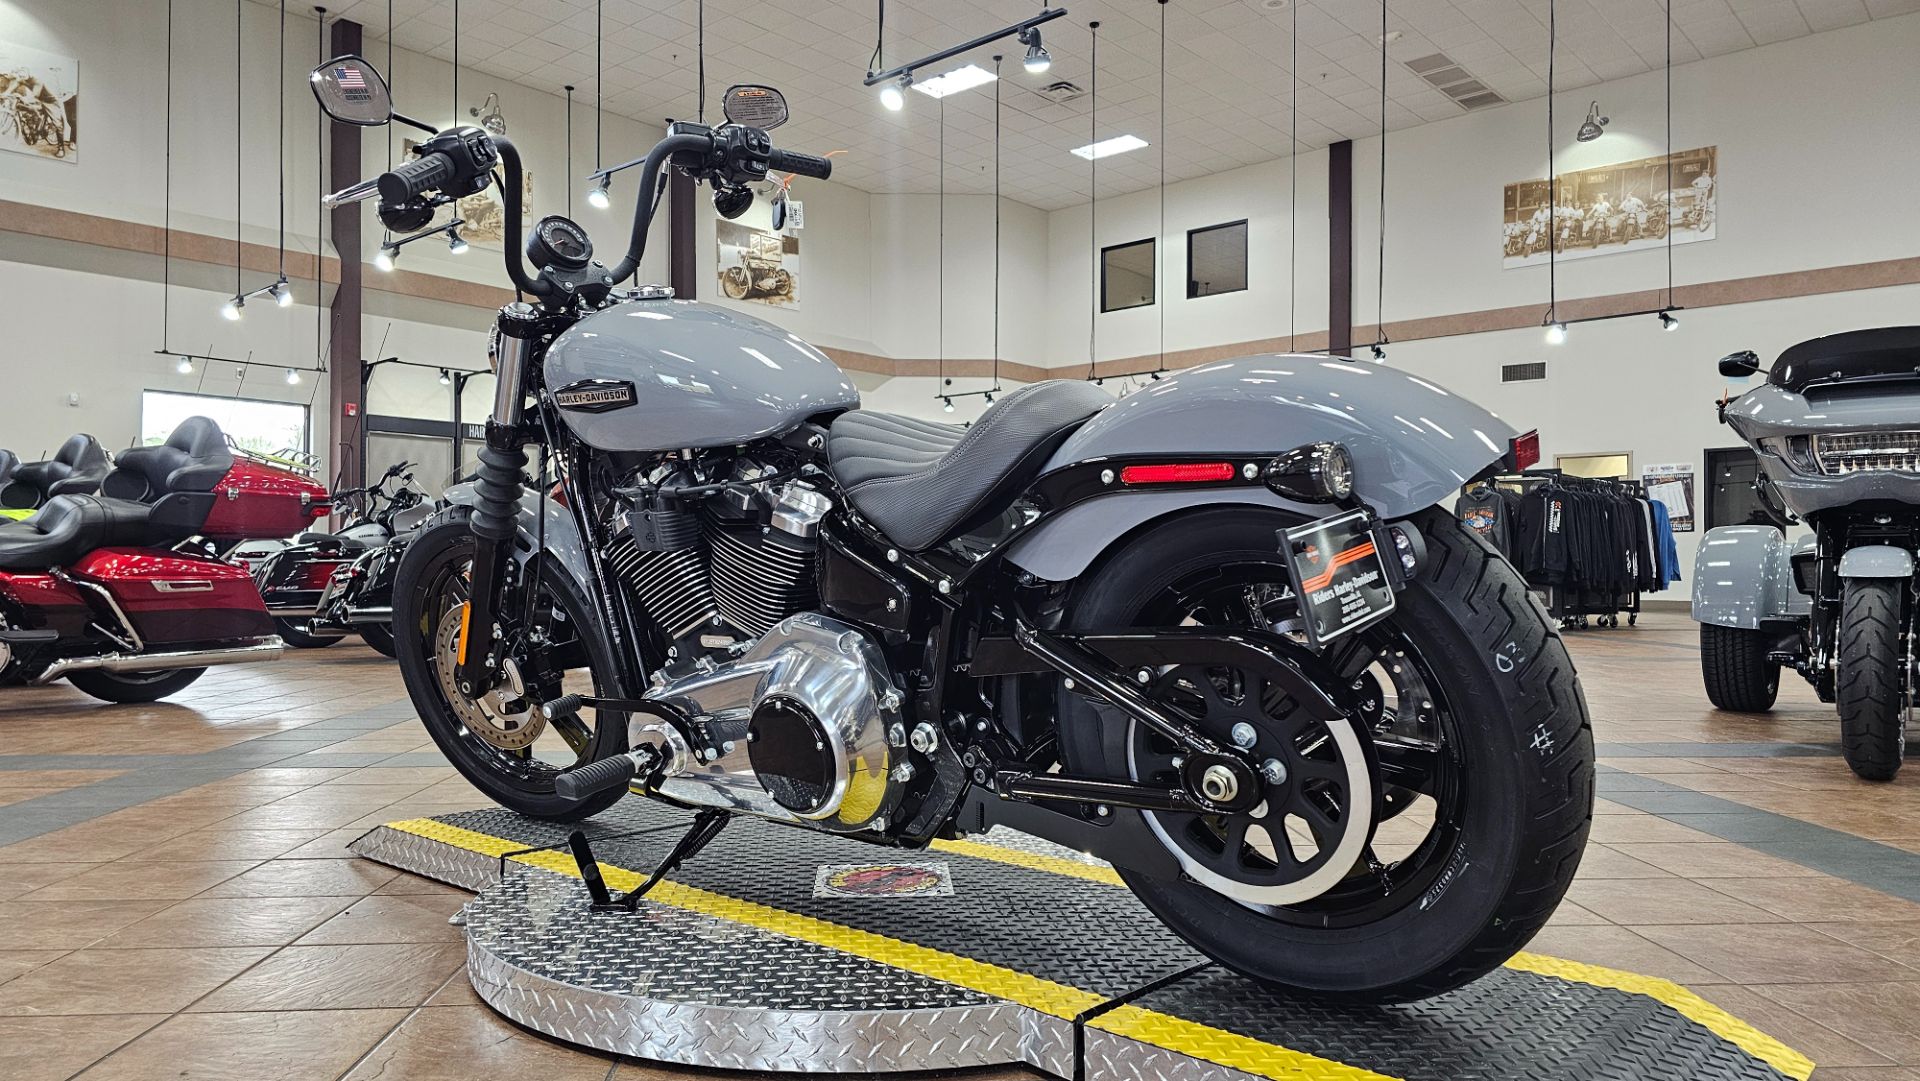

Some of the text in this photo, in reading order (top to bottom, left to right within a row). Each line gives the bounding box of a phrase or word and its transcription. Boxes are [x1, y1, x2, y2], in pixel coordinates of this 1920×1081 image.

[558, 389, 628, 404] HARLEY-DAVIDSON
[1312, 589, 1335, 605] Riders
[1334, 571, 1379, 596] Harley-Davidson
